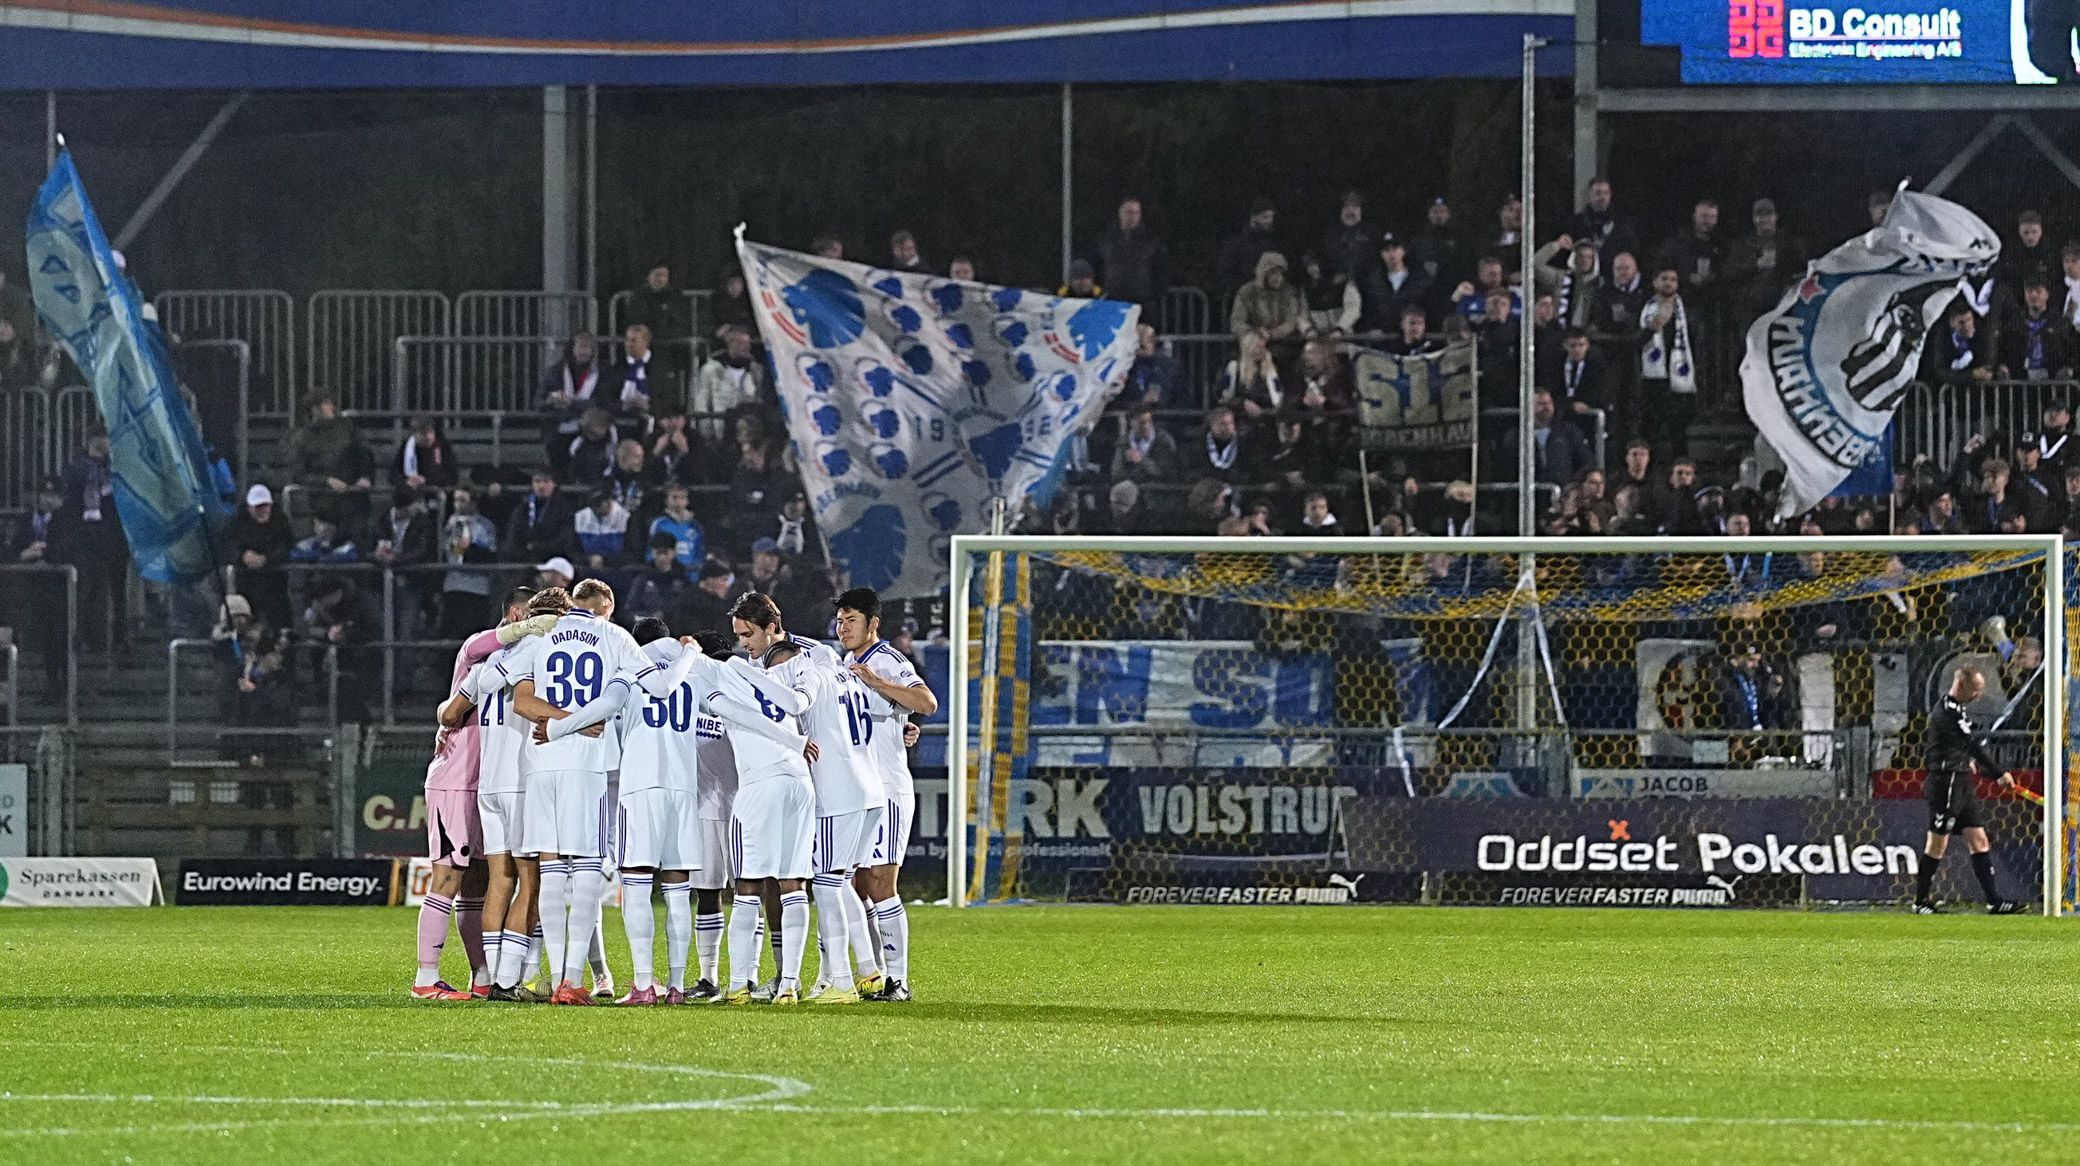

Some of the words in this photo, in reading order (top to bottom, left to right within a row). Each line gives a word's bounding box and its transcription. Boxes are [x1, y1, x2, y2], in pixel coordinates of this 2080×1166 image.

[1790, 8, 1835, 38] BD
[1842, 7, 1961, 38] Consult
[551, 629, 600, 646] DADASON
[546, 651, 603, 708] 39
[838, 690, 873, 746] 16
[1639, 776, 1709, 793] JACOB
[1477, 834, 1680, 872] Oddset
[1698, 833, 1919, 875] Pokalen
[19, 868, 141, 887] Sparekassen
[184, 872, 293, 891] Eurowind
[297, 872, 379, 896] Energy
